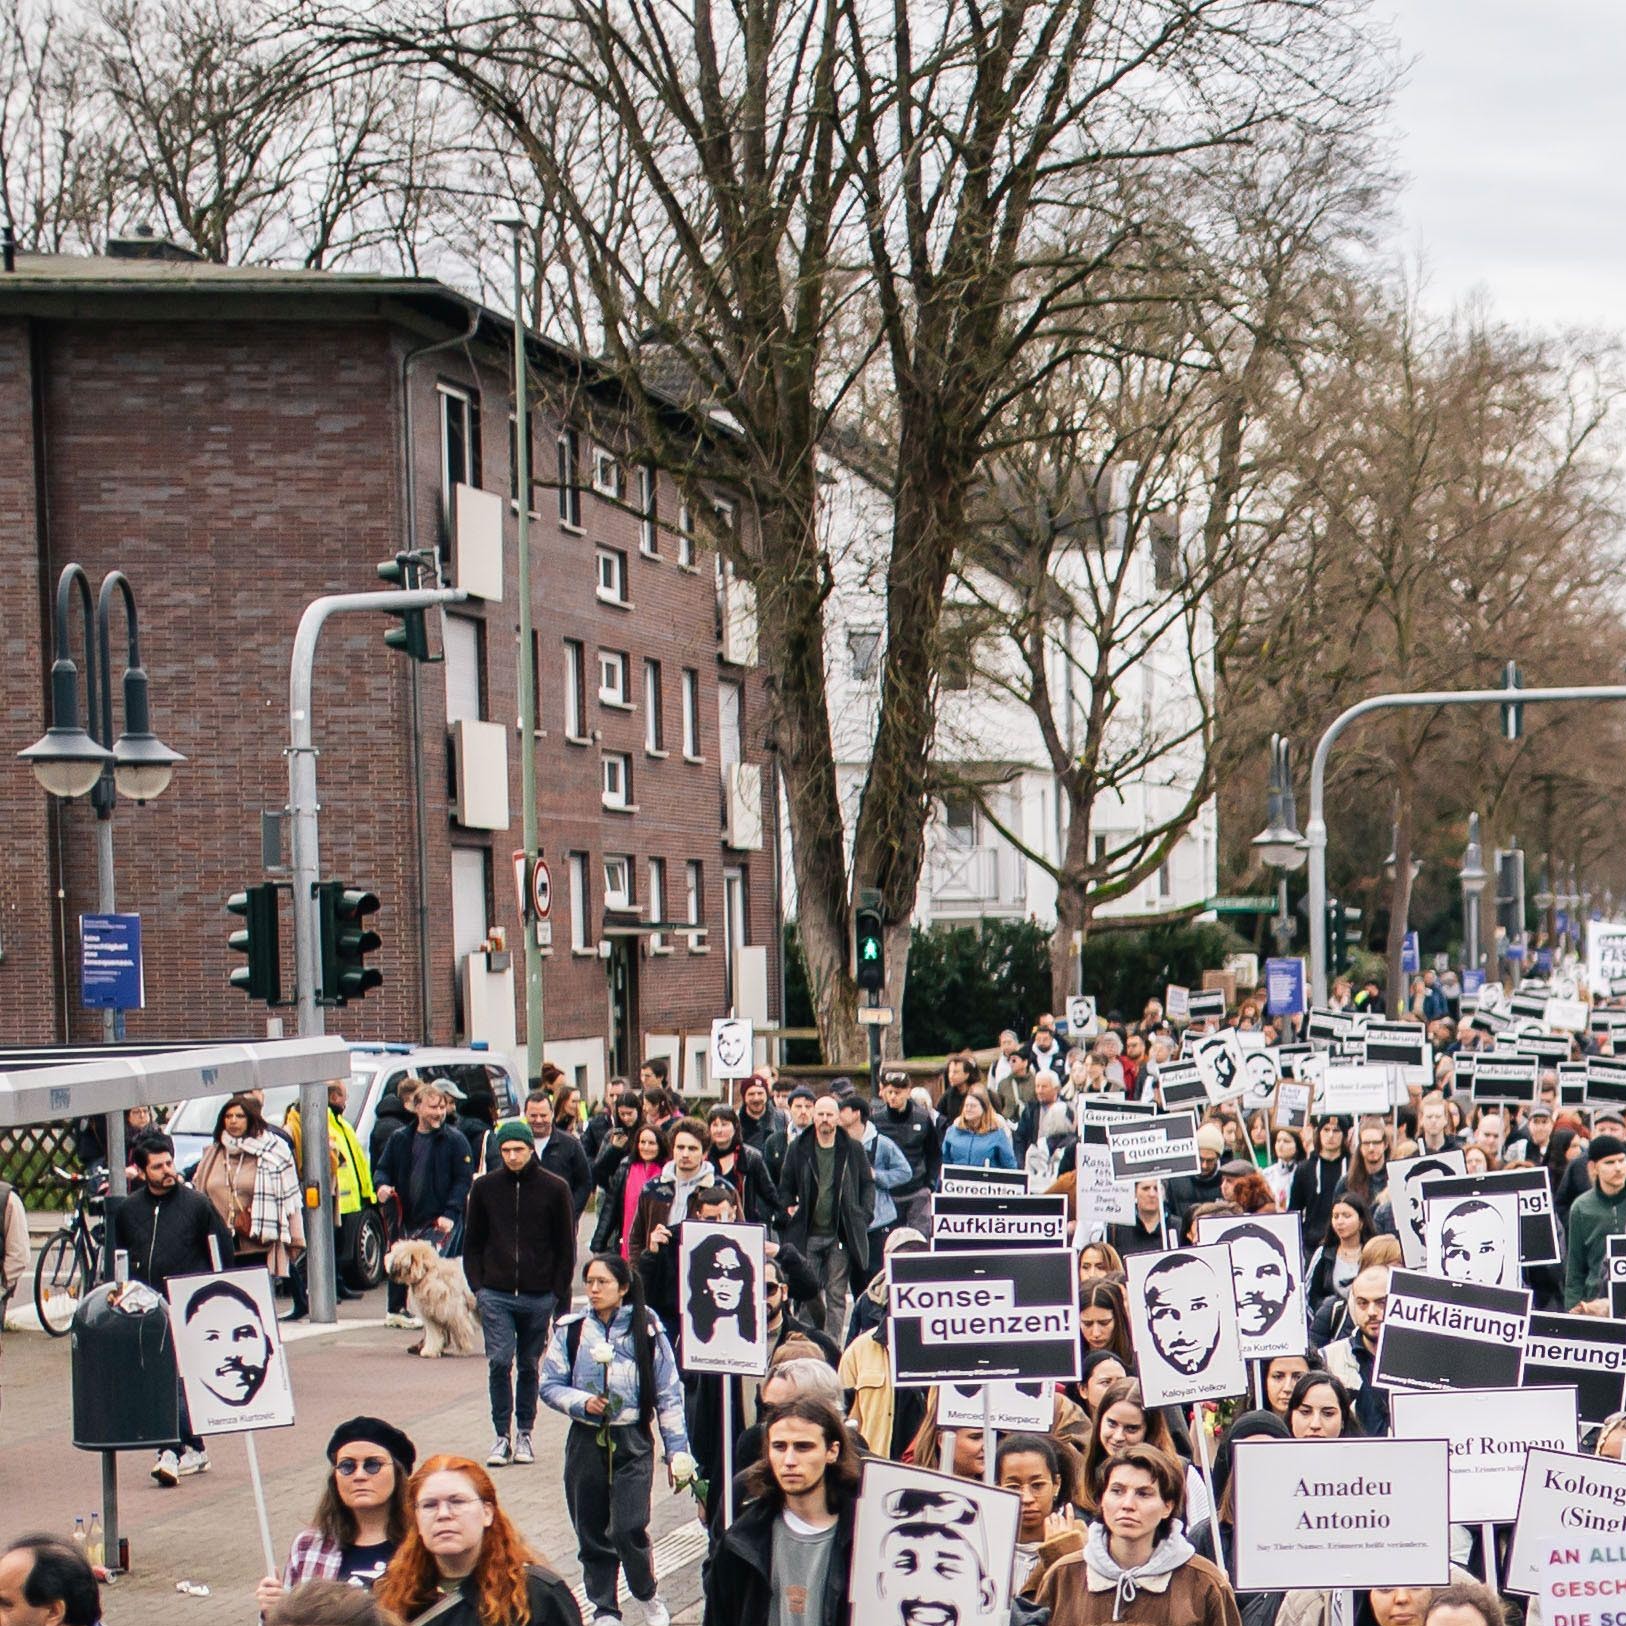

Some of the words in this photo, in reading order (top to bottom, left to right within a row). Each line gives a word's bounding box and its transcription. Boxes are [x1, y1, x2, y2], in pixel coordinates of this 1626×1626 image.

[1112, 1133, 1163, 1149] Konse-
[1129, 1140, 1195, 1160] quenzen!
[936, 1216, 1064, 1238] Aufklärung!
[897, 1286, 1006, 1310] Konse-
[931, 1309, 1072, 1340] quenzen!
[1388, 1297, 1525, 1344] Aufklärung!
[947, 1409, 995, 1422] Merceds
[1293, 1475, 1393, 1497] Amadeu
[1544, 1469, 1626, 1506] Kolong
[1296, 1509, 1392, 1530] Antonio
[1549, 1547, 1581, 1566] AN
